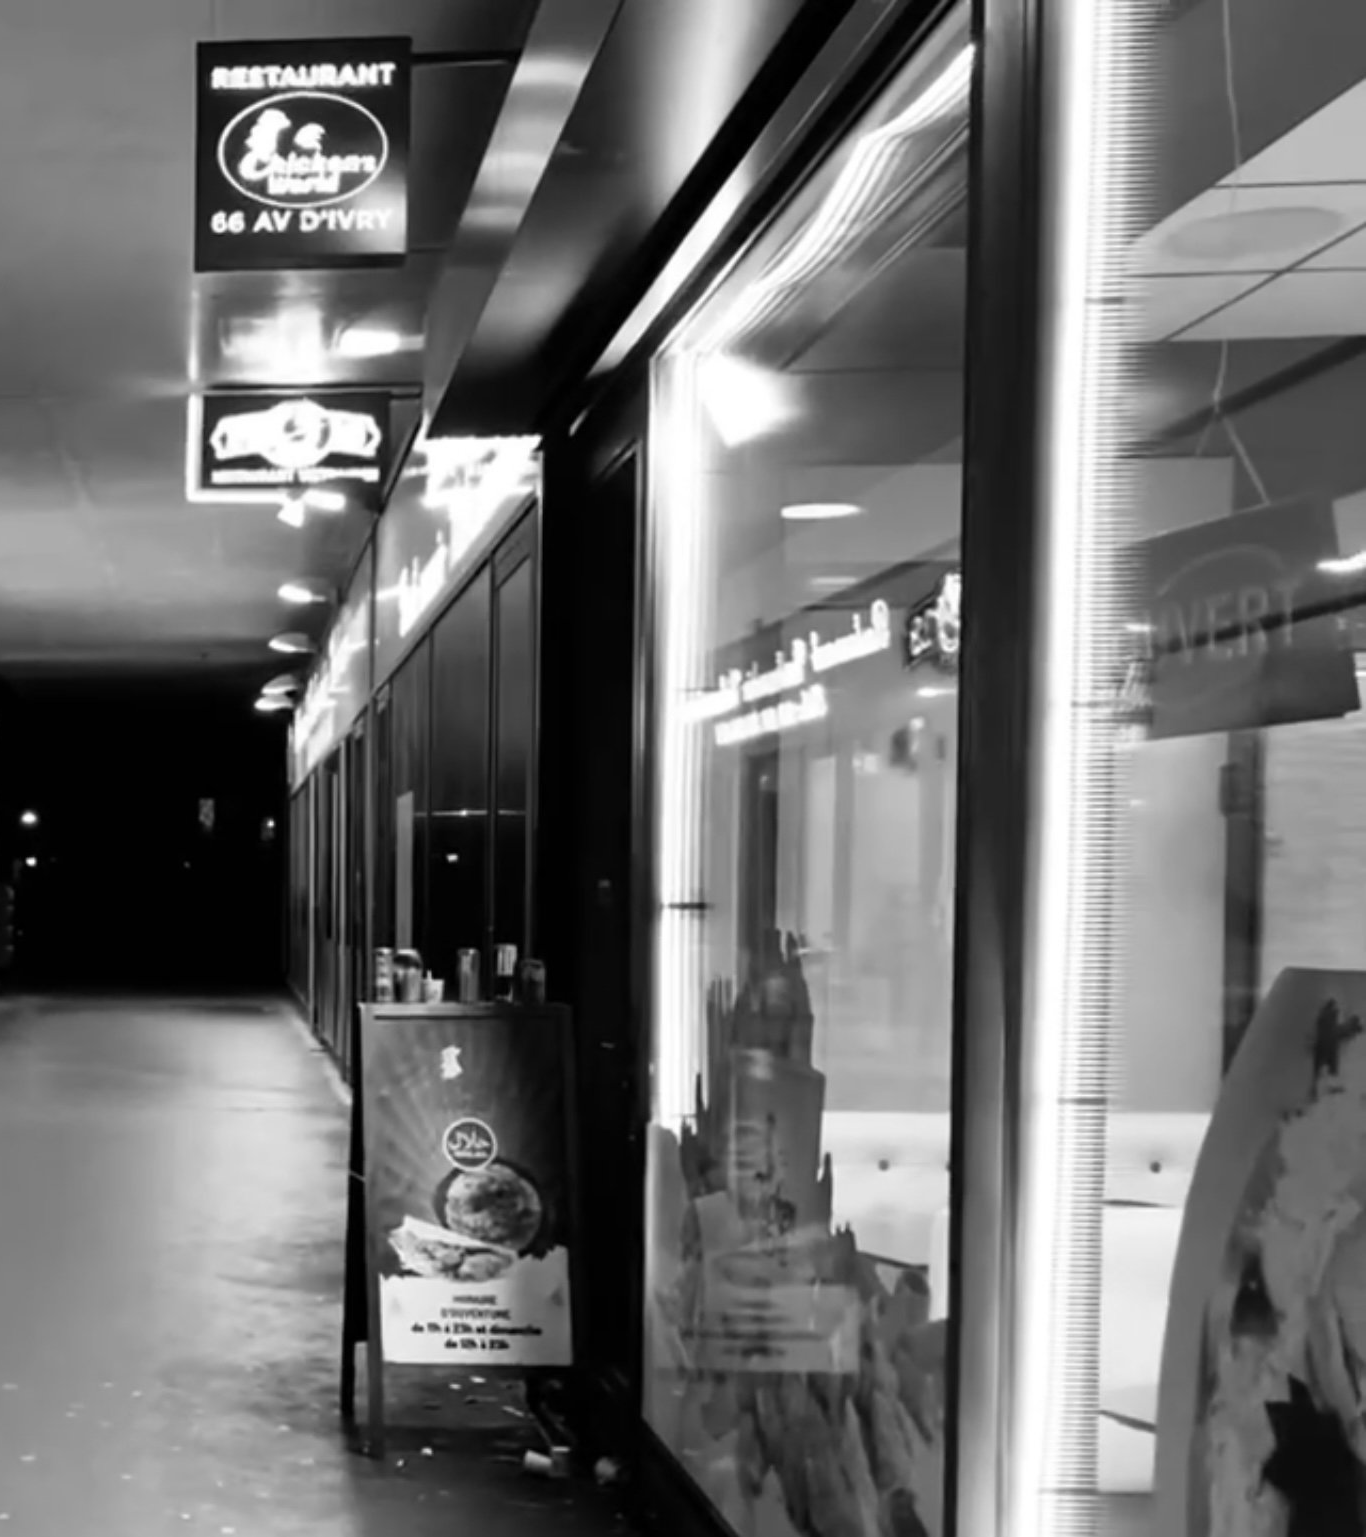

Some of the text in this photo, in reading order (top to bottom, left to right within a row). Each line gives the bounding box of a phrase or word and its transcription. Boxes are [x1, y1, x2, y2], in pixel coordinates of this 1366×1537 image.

[211, 63, 395, 89] RESTAURANT
[211, 208, 392, 233] 66 AV D'IVRY
